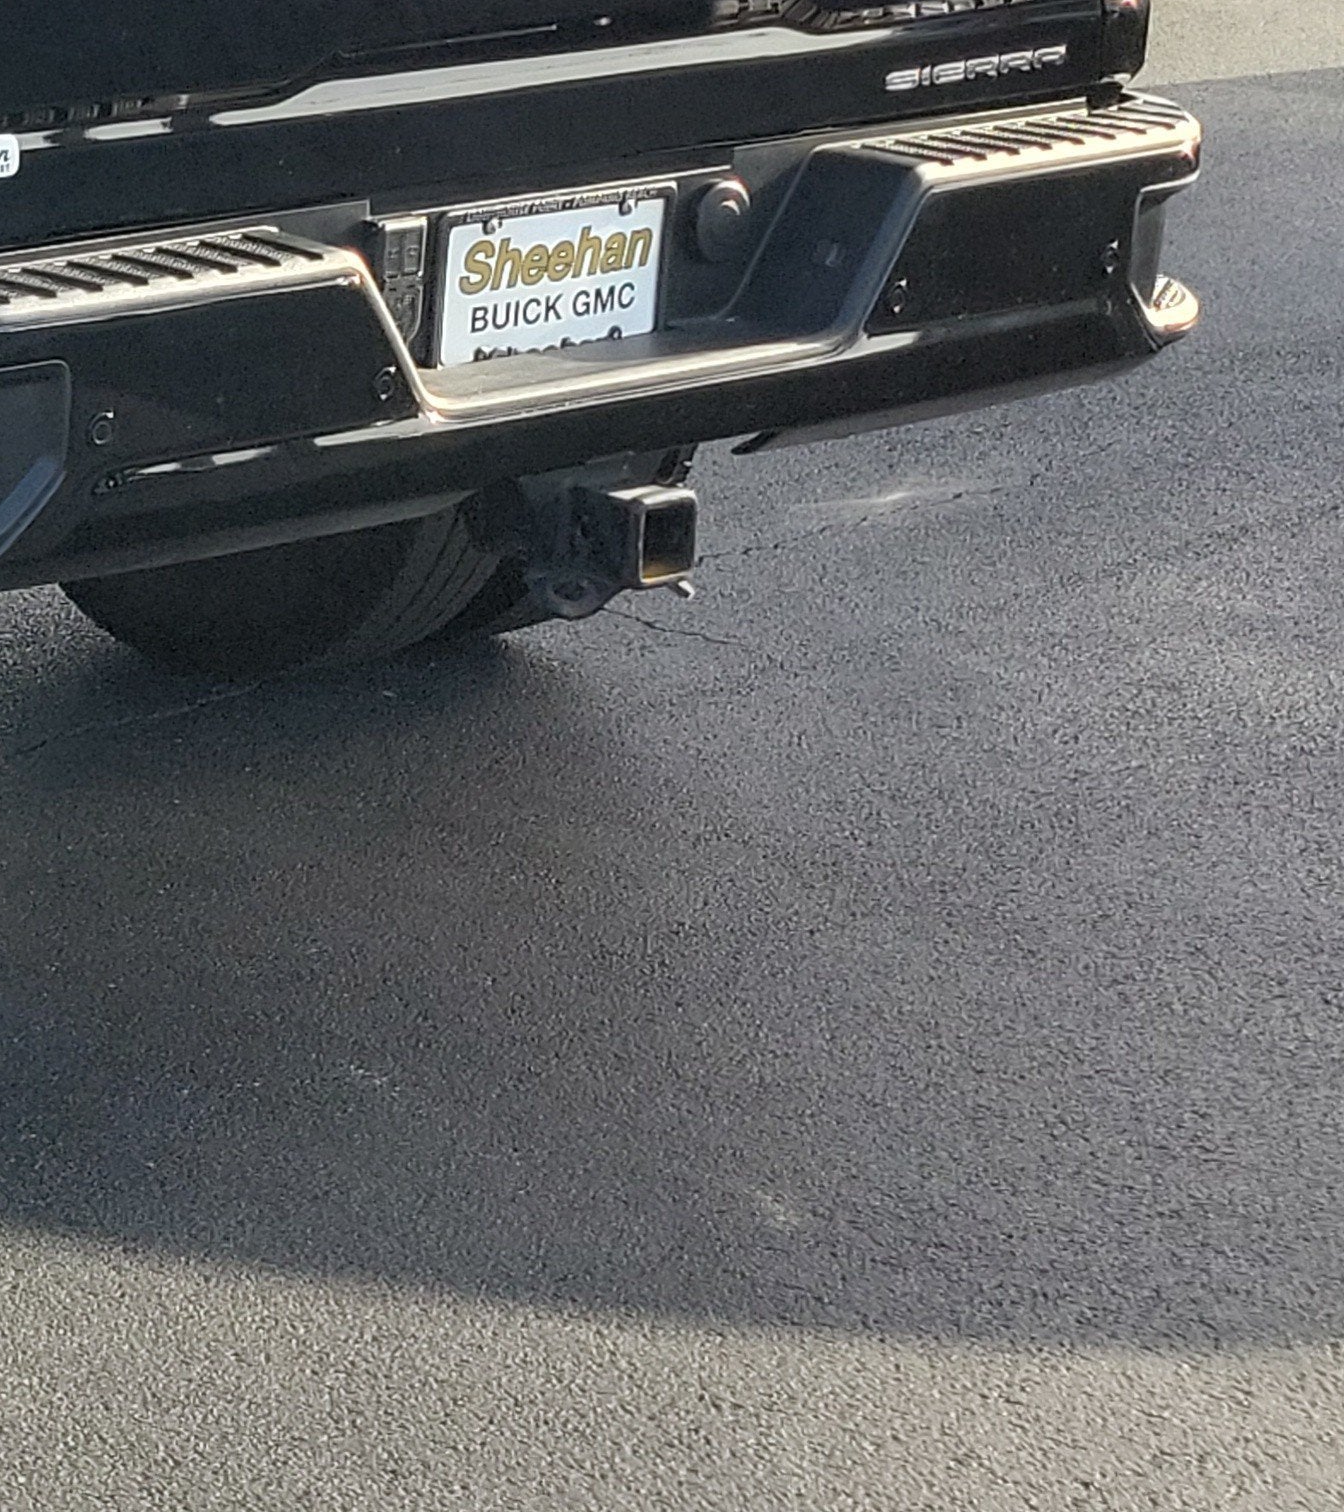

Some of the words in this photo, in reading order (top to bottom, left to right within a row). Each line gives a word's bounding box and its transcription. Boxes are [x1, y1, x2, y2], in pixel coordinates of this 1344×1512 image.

[884, 43, 1068, 92] SIERRA
[459, 225, 654, 296] Sheehan
[469, 293, 564, 334] BUICK
[571, 281, 636, 318] GMC
